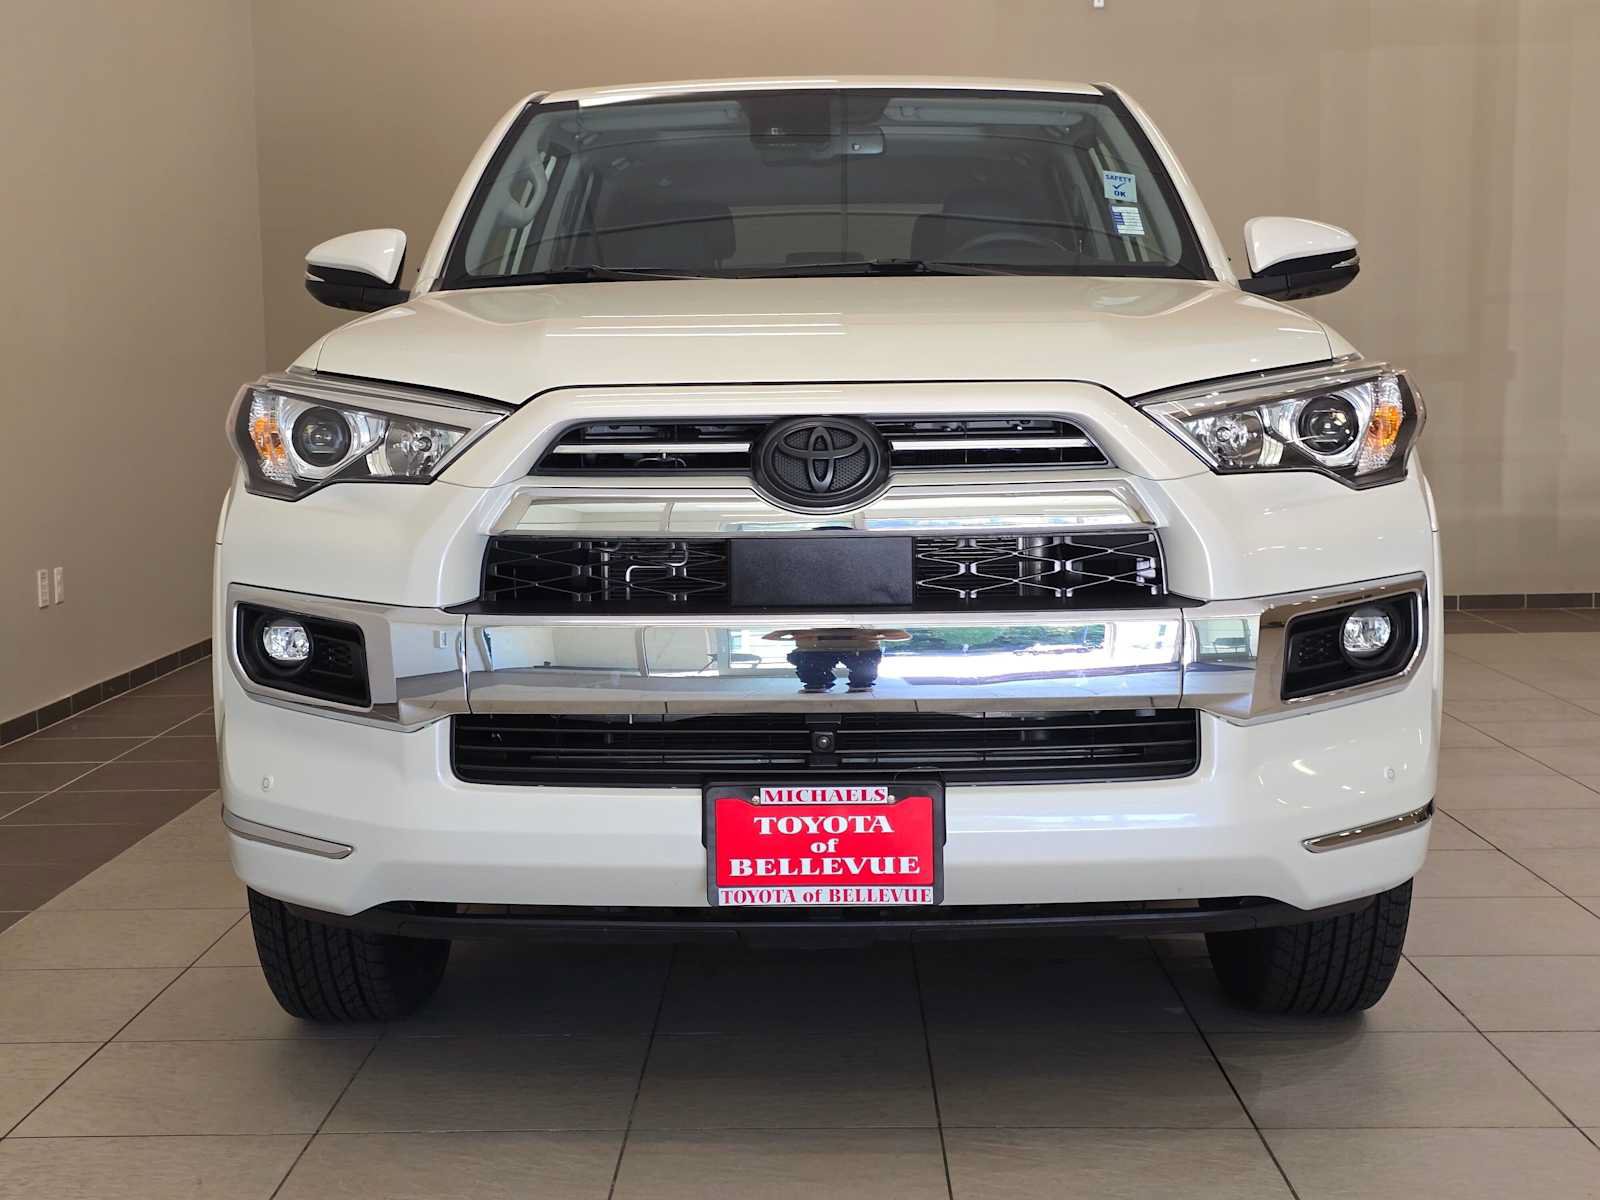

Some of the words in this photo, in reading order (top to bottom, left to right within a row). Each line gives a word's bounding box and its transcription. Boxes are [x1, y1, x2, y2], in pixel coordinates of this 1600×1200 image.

[1105, 174, 1131, 183] SAFETY
[764, 788, 886, 802] MICHAELS
[754, 815, 895, 835] TOYOTA
[810, 838, 839, 854] of
[728, 856, 921, 877] BELLEVUE
[721, 888, 796, 904] TOYOTA
[802, 888, 823, 903] of
[828, 888, 932, 904] BELLEVUE
